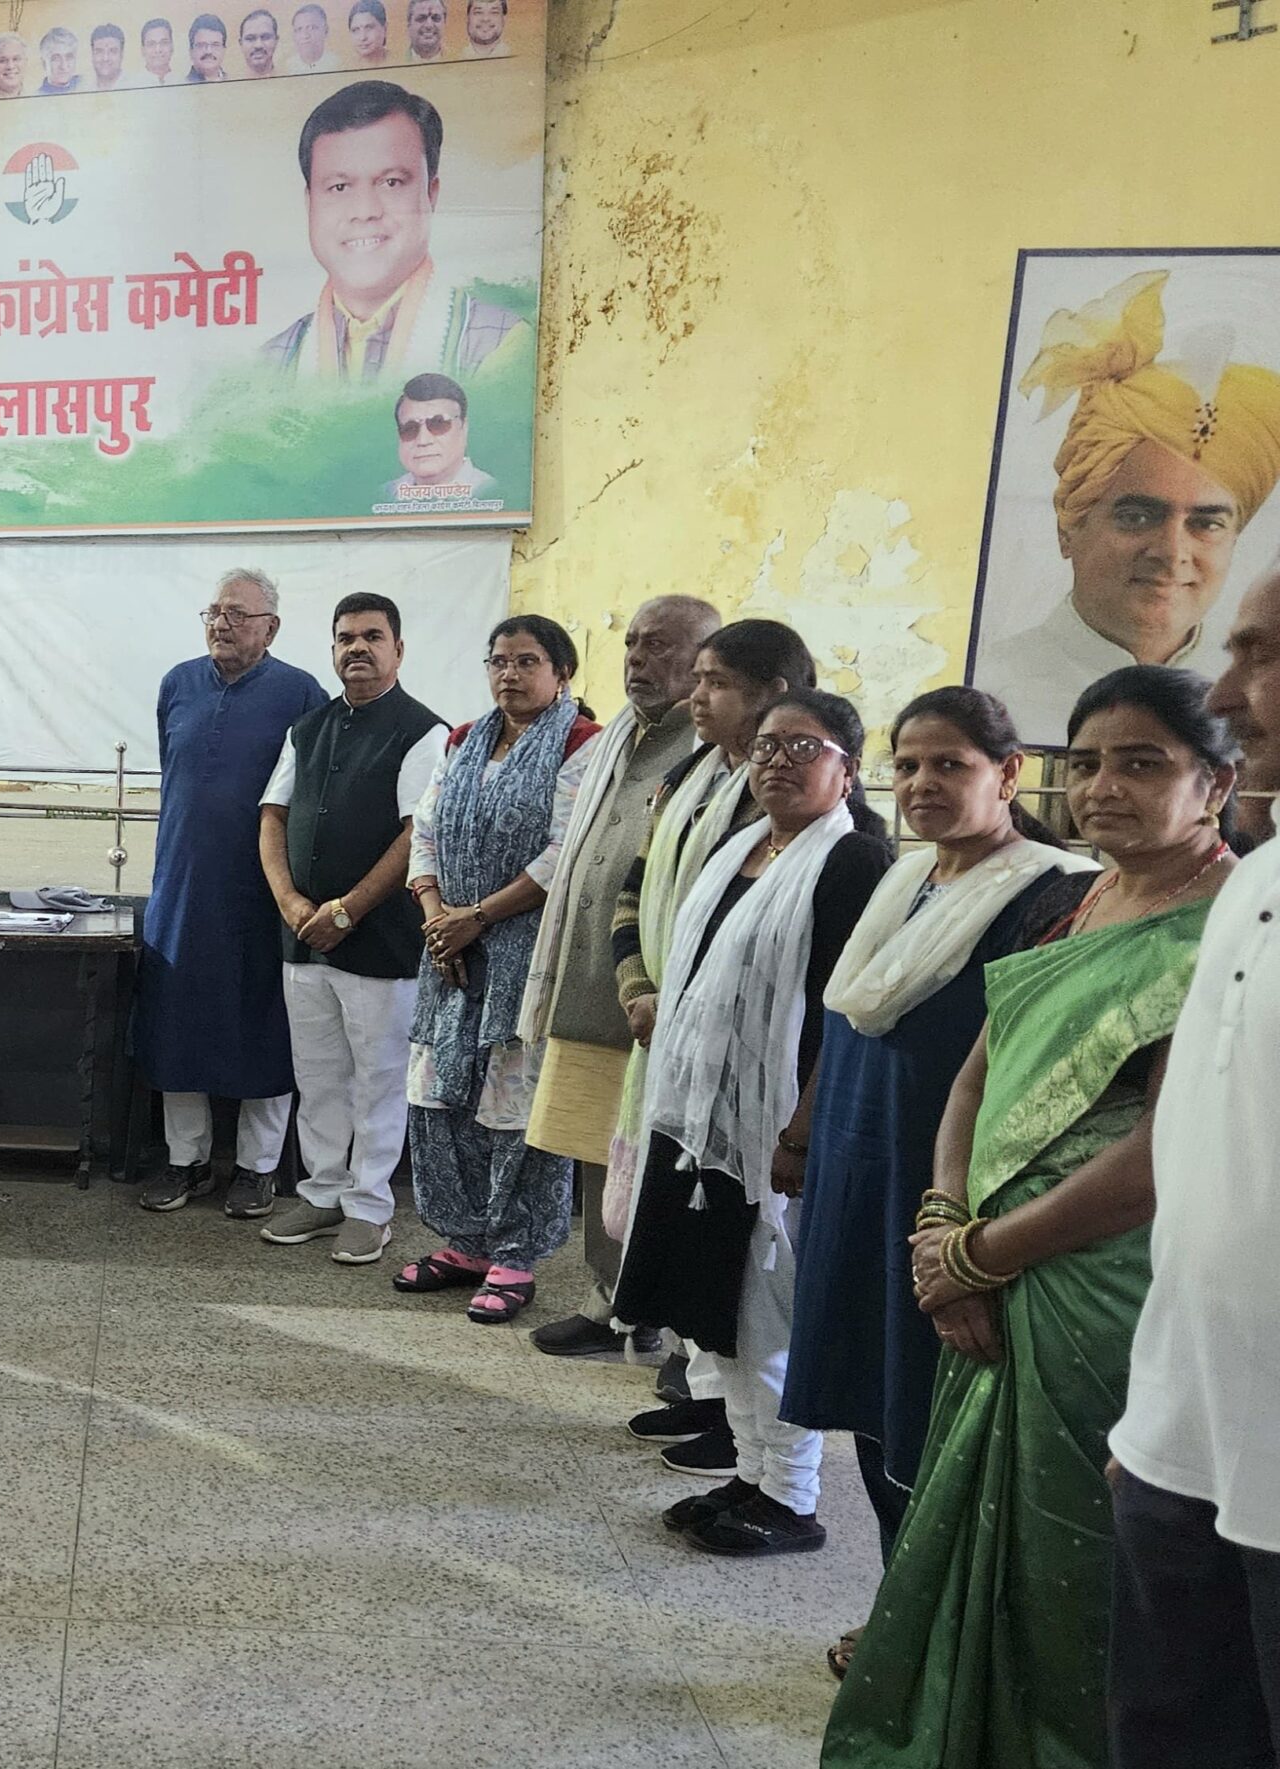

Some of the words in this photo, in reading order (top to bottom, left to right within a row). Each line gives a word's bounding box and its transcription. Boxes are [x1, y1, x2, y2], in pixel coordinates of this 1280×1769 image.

[125, 250, 263, 330] कमेटी
[399, 484, 432, 498] विजय
[434, 484, 472, 498] पाण्डेय
